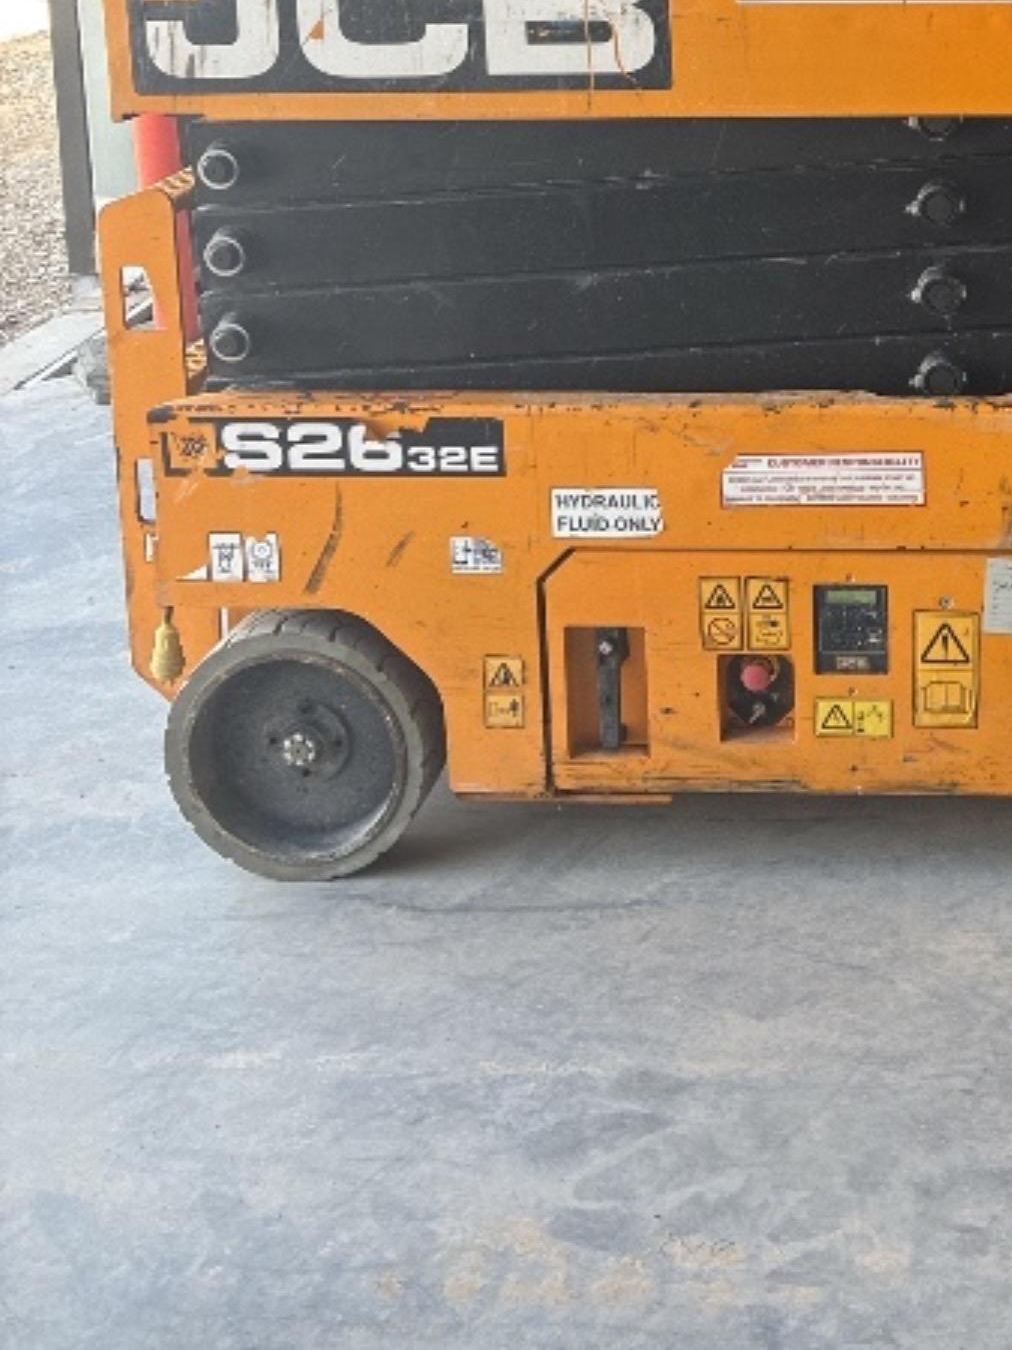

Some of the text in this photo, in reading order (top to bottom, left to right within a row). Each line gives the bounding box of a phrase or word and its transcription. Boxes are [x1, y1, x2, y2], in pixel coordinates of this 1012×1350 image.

[221, 422, 402, 471] S26
[407, 446, 499, 471] 32E
[557, 515, 661, 532] FLUID ONLY
